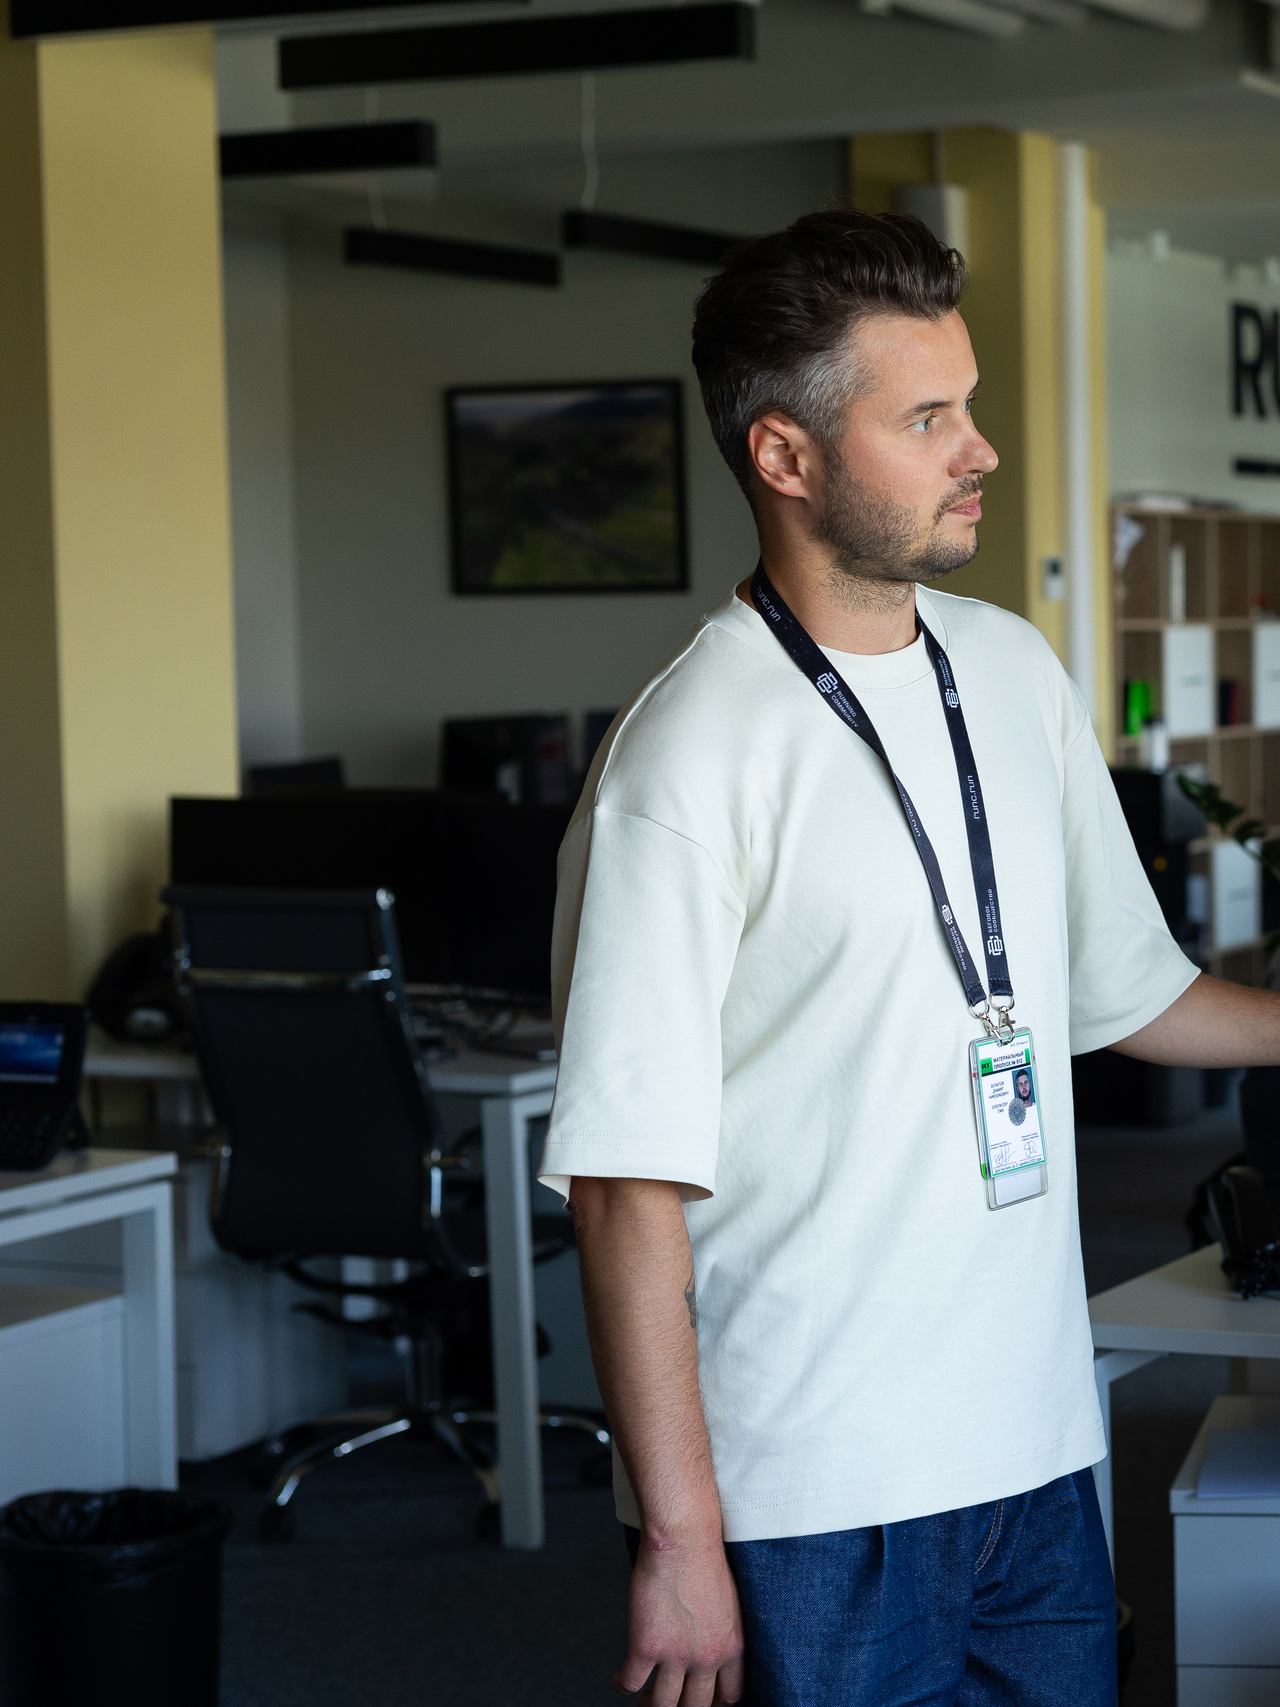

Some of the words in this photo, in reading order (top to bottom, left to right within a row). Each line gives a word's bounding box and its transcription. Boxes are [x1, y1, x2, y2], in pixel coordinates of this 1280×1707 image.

[755, 586, 781, 622] runc.run
[831, 694, 859, 728] COMMUNITY
[837, 690, 857, 718] RUNNING
[902, 793, 921, 837] runc.run
[967, 775, 980, 820] runc.run
[981, 1062, 991, 1070] RT
